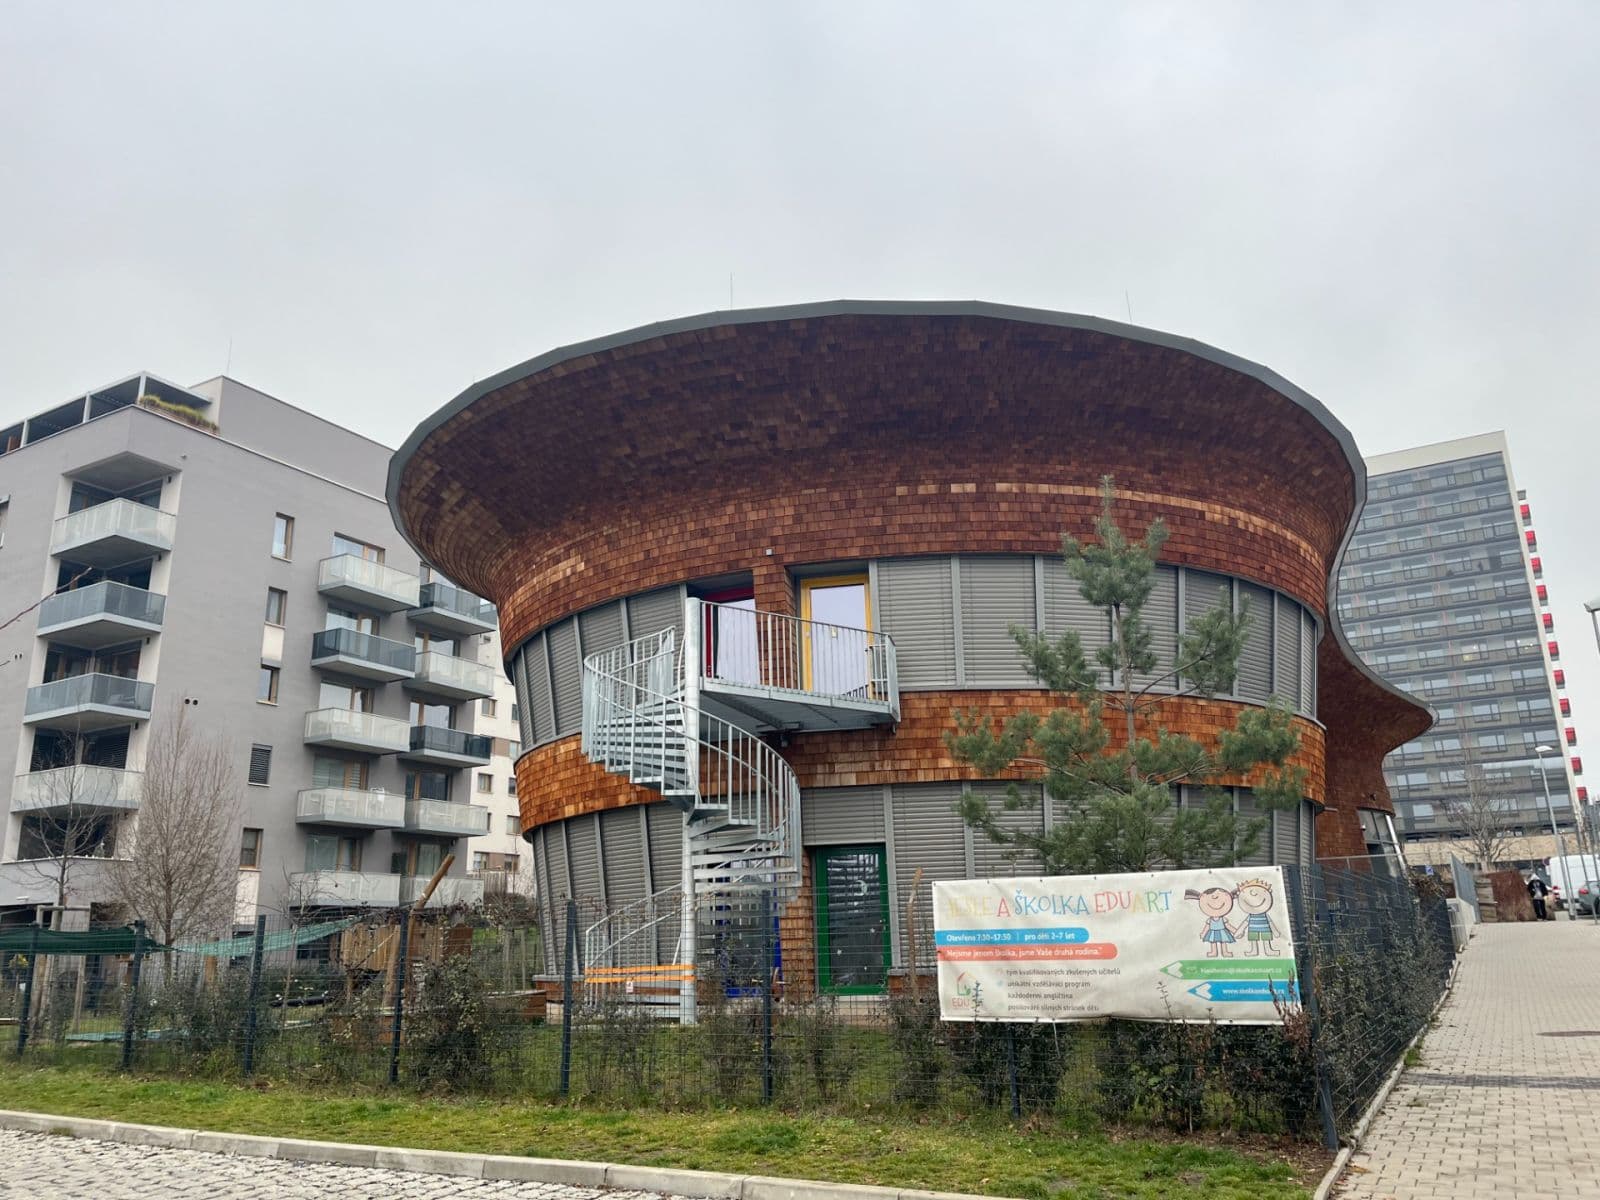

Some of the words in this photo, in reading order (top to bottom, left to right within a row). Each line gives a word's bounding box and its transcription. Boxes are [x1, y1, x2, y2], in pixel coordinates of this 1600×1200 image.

[997, 897, 1011, 917] A
[1014, 889, 1090, 915] ŠKOLKA
[1095, 890, 1172, 913] EDUART
[1024, 934, 1036, 942] pro
[1064, 931, 1076, 940] let
[1098, 967, 1121, 976] učitelů
[1064, 981, 1091, 989] program
